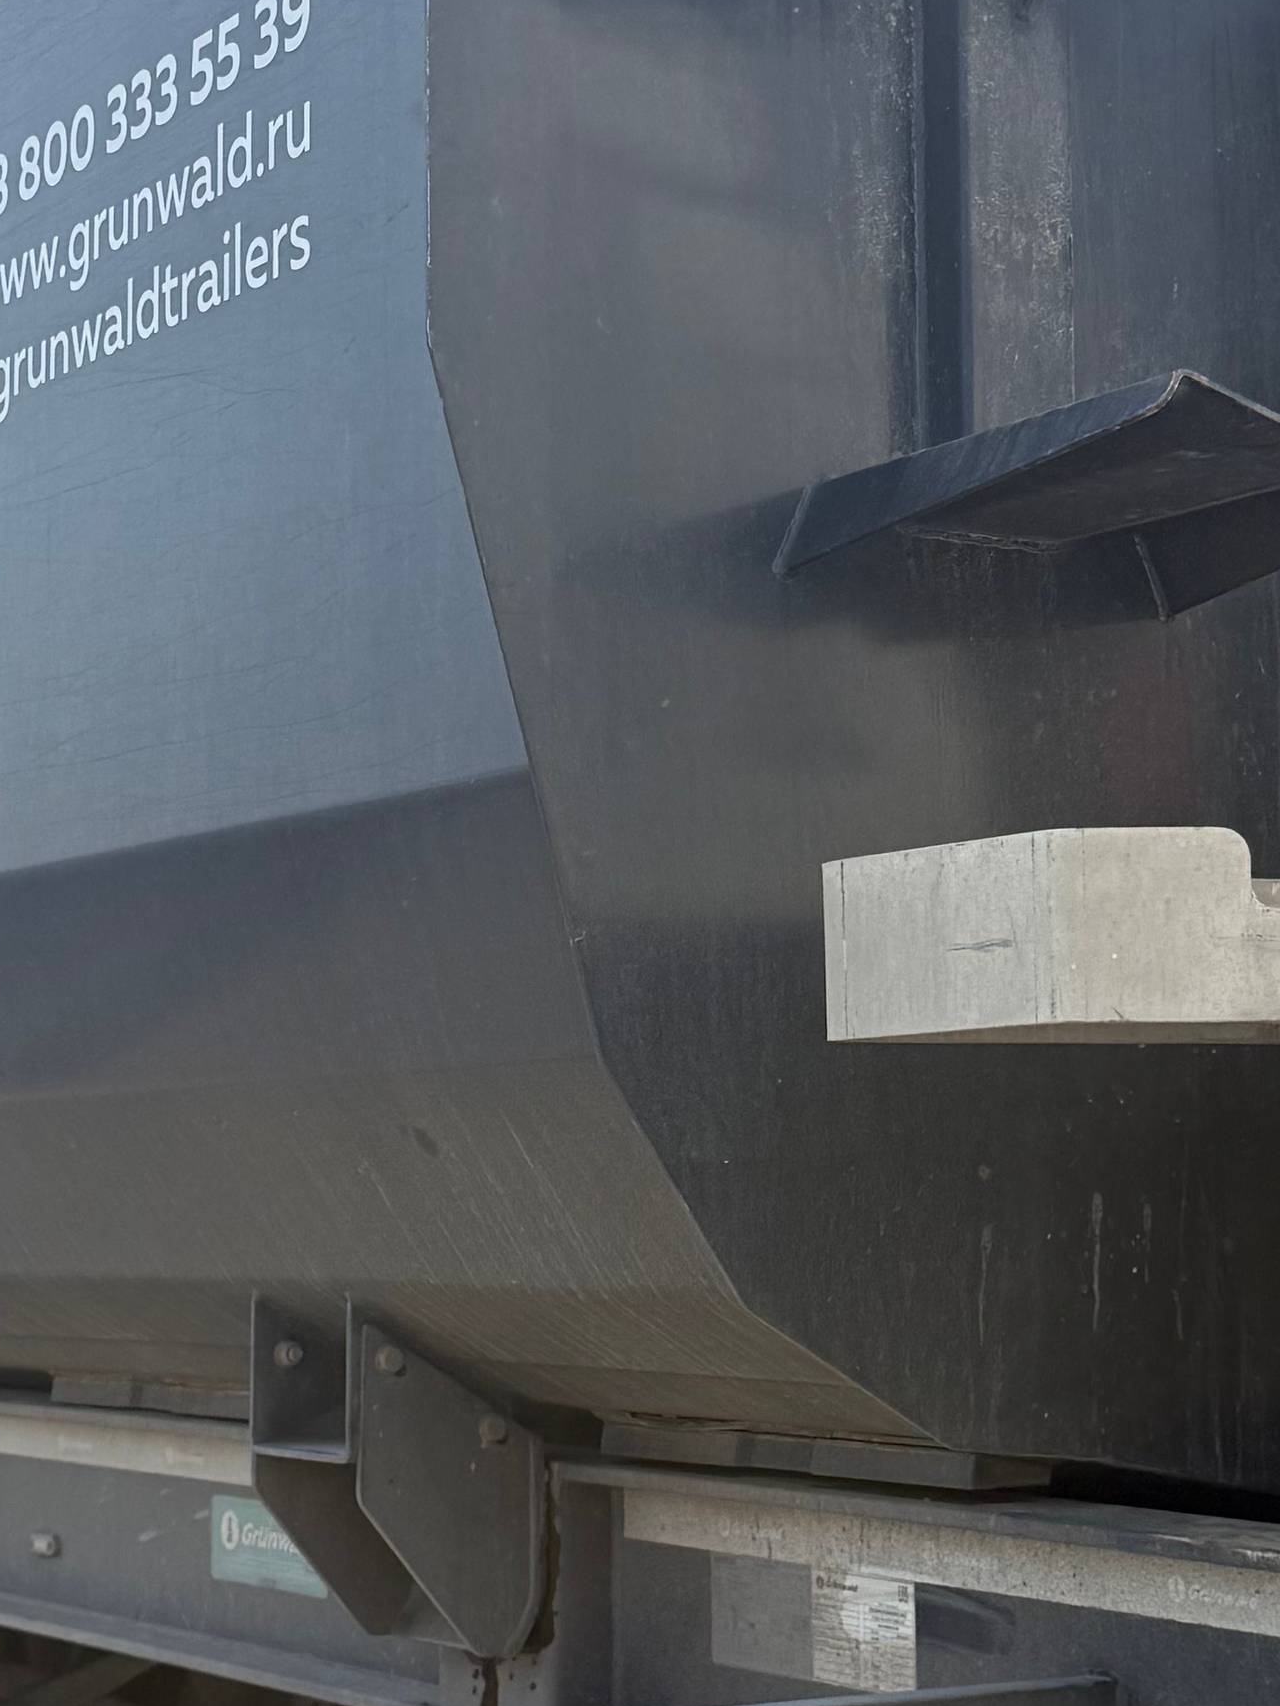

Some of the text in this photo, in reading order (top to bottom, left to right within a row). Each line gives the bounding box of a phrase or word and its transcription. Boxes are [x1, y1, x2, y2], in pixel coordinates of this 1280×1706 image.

[19, 104, 95, 201] 800
[106, 53, 178, 154] 333
[190, 13, 240, 106] 55
